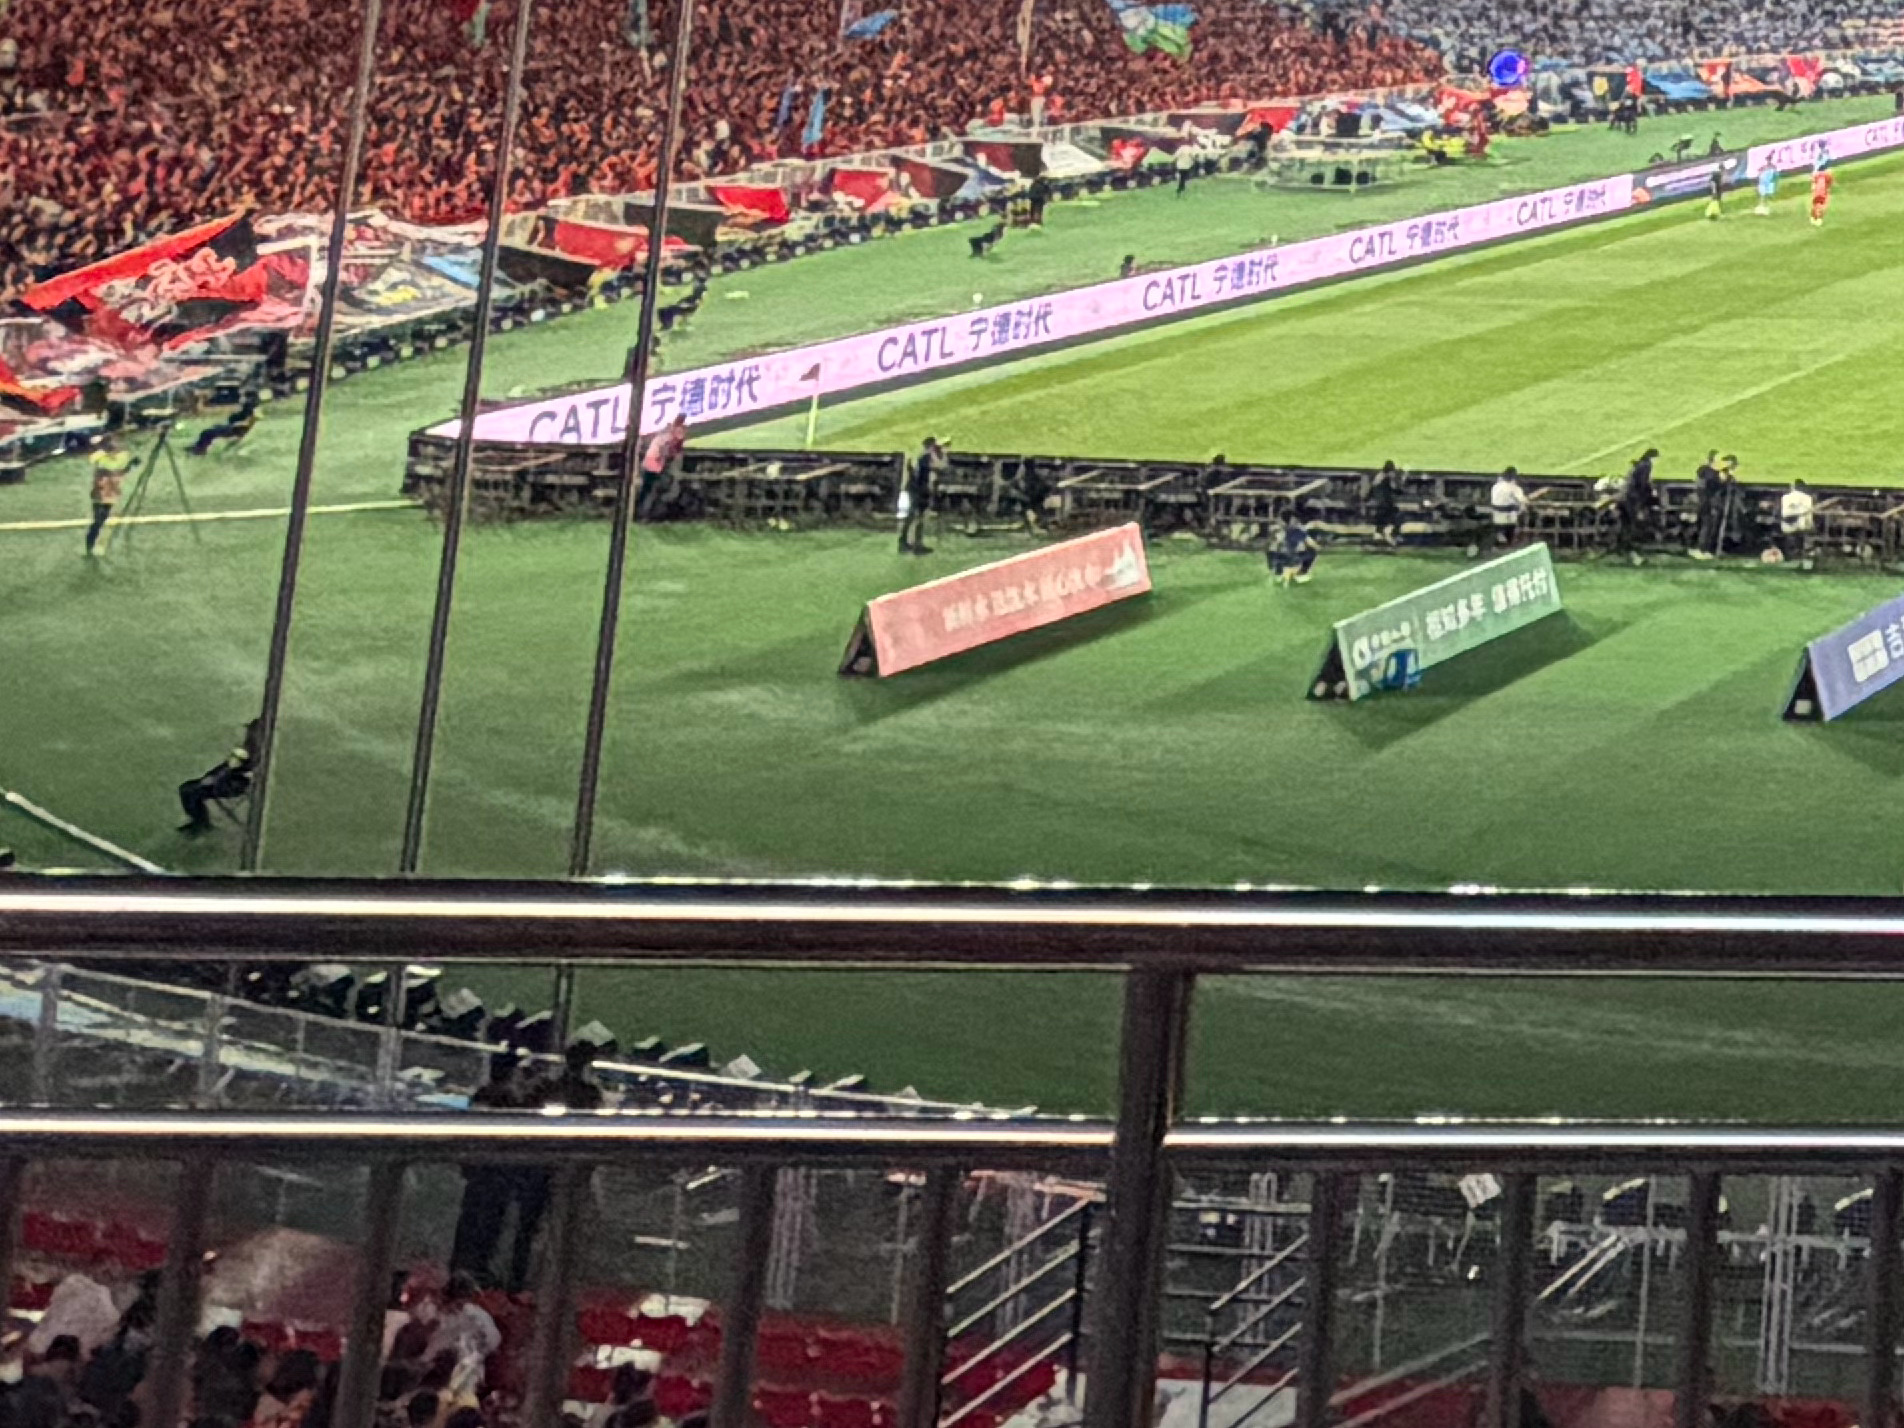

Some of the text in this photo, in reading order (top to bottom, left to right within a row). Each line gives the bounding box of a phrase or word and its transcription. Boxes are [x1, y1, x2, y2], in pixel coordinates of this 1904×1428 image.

[1349, 232, 1396, 264] CATL
[1142, 274, 1202, 313] CATL
[877, 301, 1052, 373] CATL 宁德时代
[529, 367, 760, 443] CATL 宁德时代
